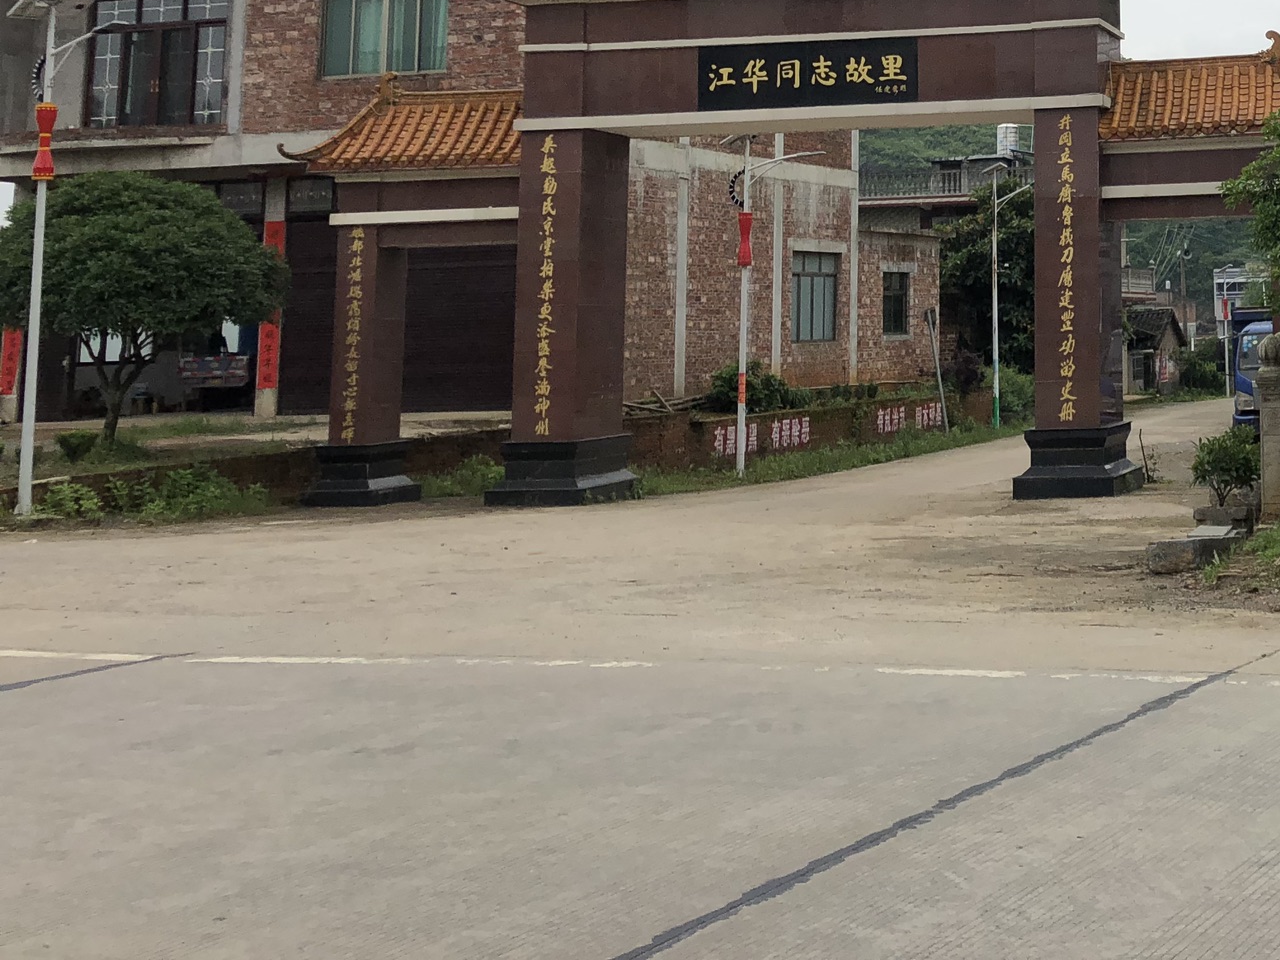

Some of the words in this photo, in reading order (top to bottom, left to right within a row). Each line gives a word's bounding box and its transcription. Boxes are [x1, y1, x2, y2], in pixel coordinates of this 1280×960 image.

[708, 54, 908, 94] 江华同志故里
[714, 423, 757, 455] 有黑黑
